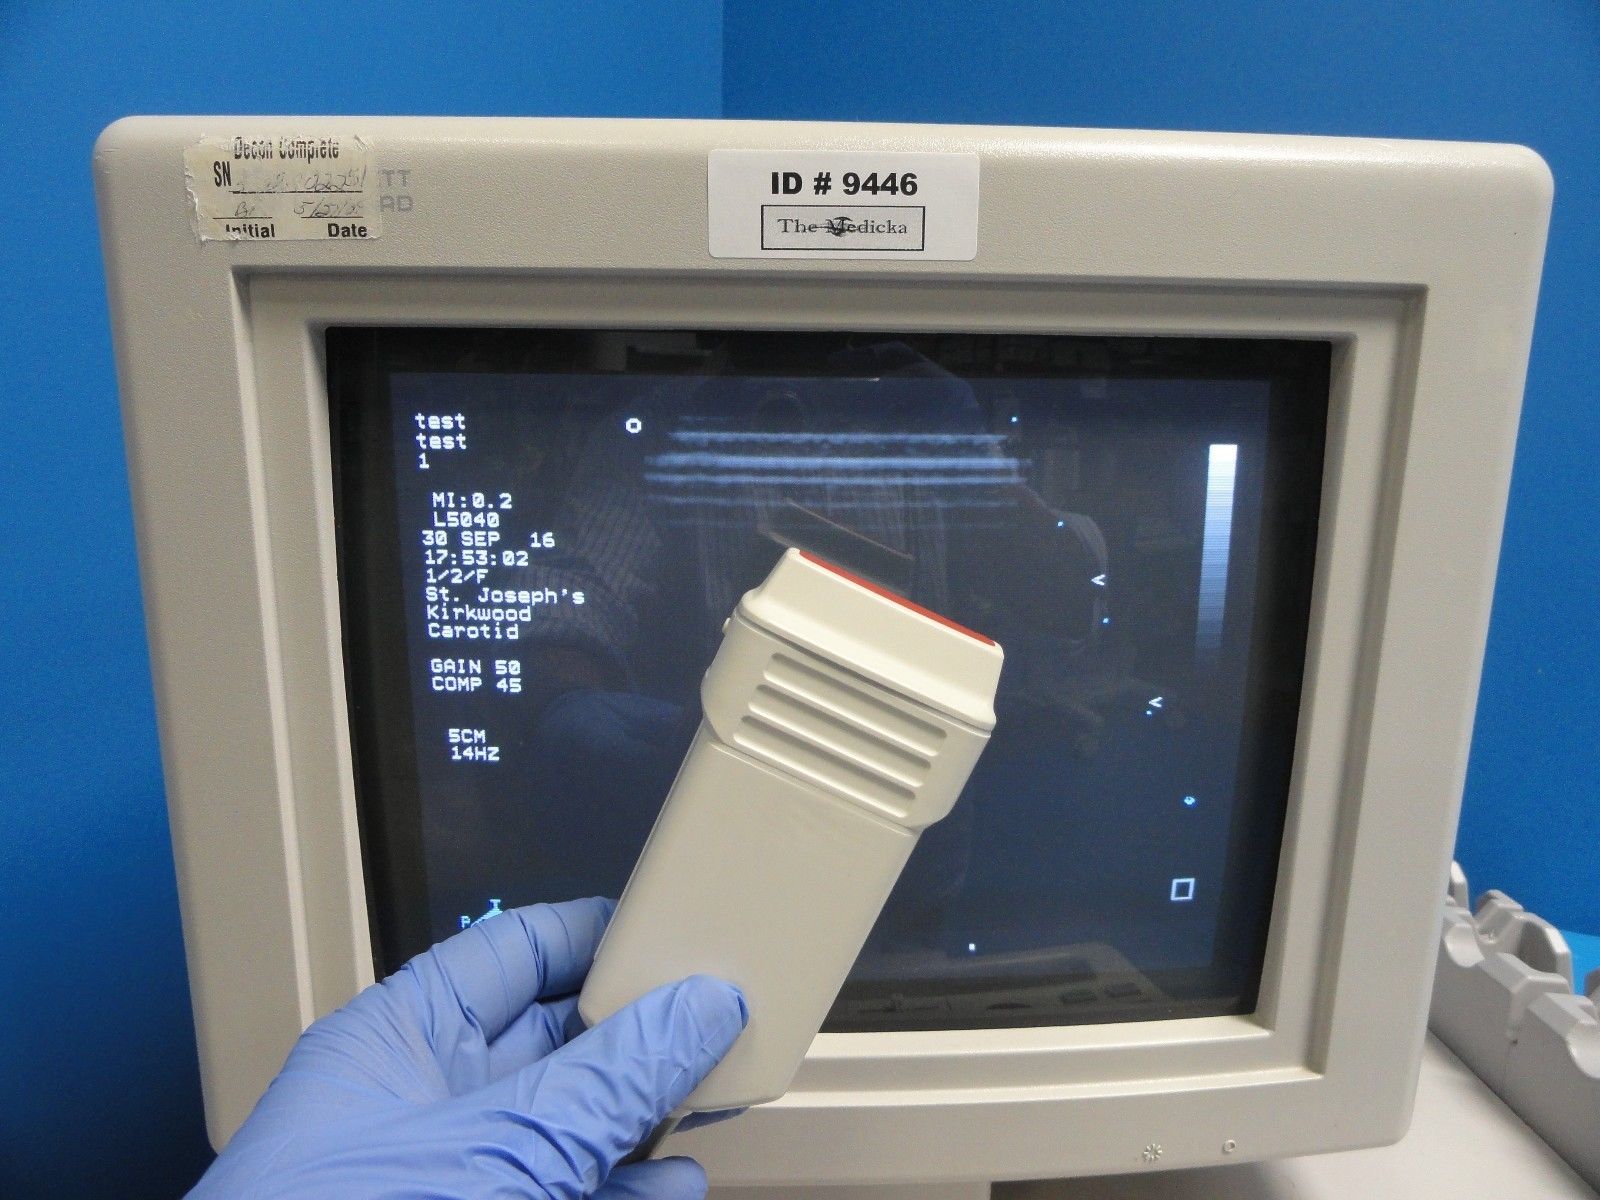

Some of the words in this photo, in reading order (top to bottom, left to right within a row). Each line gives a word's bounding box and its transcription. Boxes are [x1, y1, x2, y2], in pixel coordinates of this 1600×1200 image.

[234, 136, 273, 160] Decon
[213, 160, 232, 187] SN
[377, 169, 412, 188] TT
[772, 172, 802, 194] ID
[814, 172, 831, 194] #
[843, 173, 917, 195] 9446
[327, 223, 368, 238] Date
[777, 218, 817, 234] The
[826, 217, 908, 236] Medicka
[415, 413, 465, 429] test
[416, 433, 466, 449] test
[419, 453, 429, 469] 1
[433, 492, 512, 509] MI:0.2
[434, 511, 499, 528] L5040
[422, 530, 447, 546] 30
[461, 531, 500, 546] SEP
[530, 532, 555, 548] 16
[425, 549, 528, 566] 17:53:02
[427, 568, 488, 583] 1/2/F
[426, 586, 459, 602] St.
[478, 587, 585, 606] Joseph's
[427, 603, 533, 621] Kirkwood
[428, 622, 518, 639] Carotid
[431, 658, 481, 674] GAIN
[495, 660, 520, 675] 50
[432, 676, 482, 691] COMP
[496, 678, 521, 692] 45
[449, 729, 486, 743] 5CM
[452, 746, 499, 761] 14HZ
